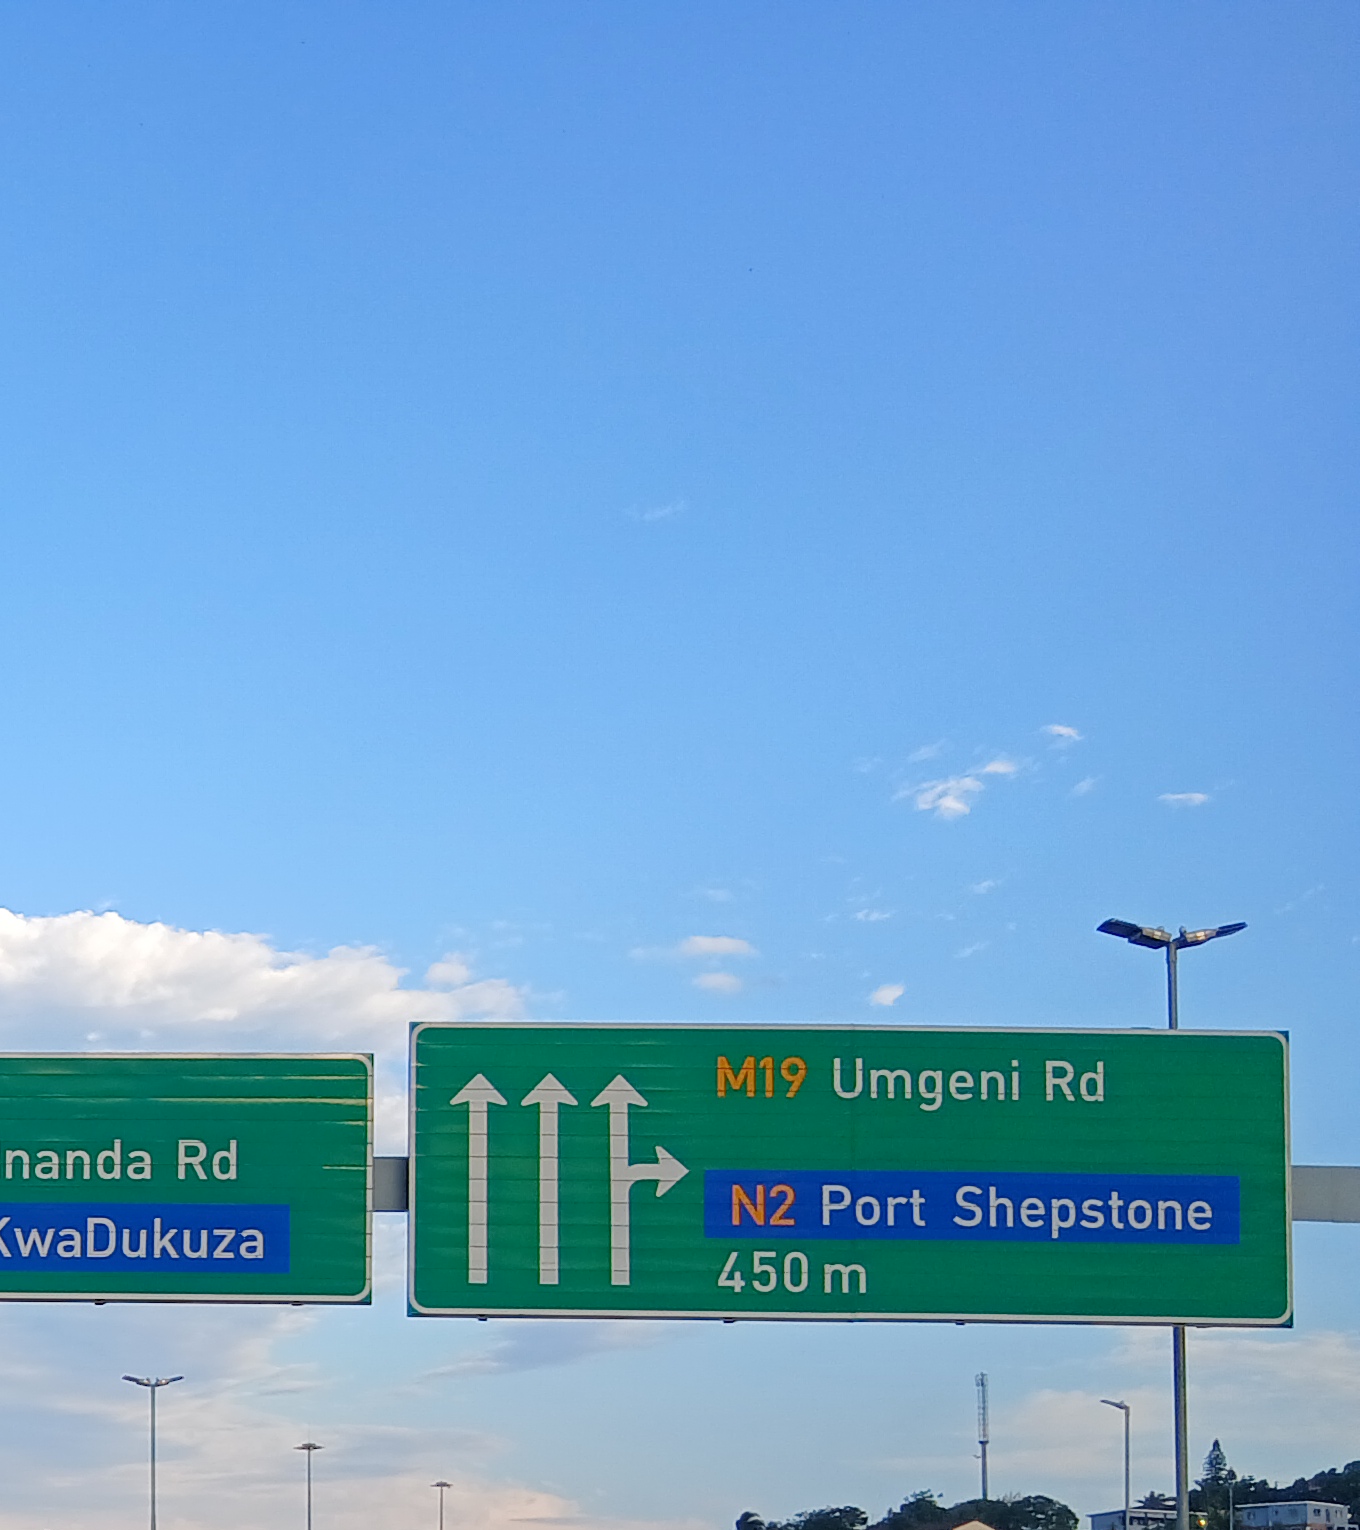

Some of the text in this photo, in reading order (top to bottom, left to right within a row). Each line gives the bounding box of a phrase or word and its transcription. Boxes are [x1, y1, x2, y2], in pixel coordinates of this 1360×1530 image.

[717, 1056, 1104, 1111] M19 Umgeni Rd
[178, 1140, 236, 1180] Rd
[732, 1185, 1212, 1238] N2 Port Shepstone
[718, 1251, 866, 1293] 450 m
